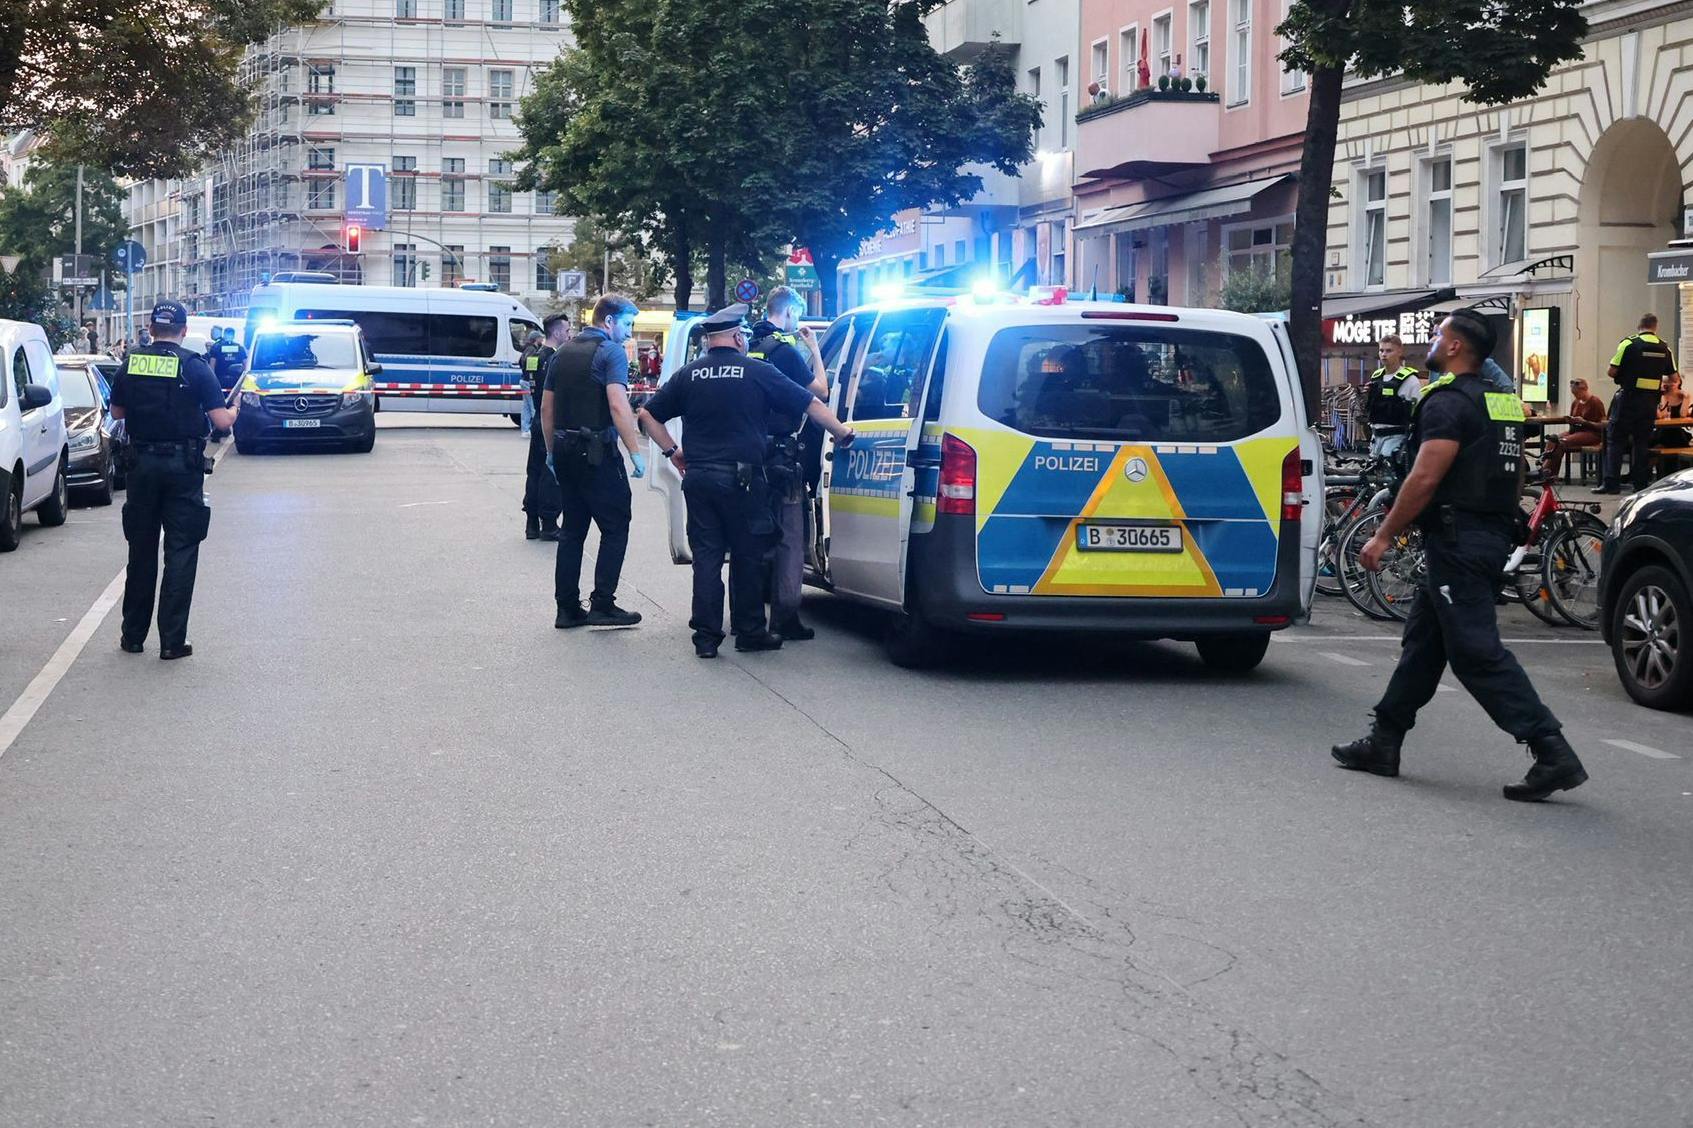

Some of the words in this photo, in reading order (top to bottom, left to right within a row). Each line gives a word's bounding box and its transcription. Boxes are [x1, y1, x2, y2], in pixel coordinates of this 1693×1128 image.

[348, 165, 384, 209] T
[1657, 264, 1689, 278] Krombacher
[156, 304, 178, 313] POLIZEI
[1333, 314, 1372, 344] MÖGE
[1372, 319, 1397, 343] TEE
[129, 355, 179, 376] POLIZEI
[691, 365, 744, 382] POLIZEI
[450, 374, 484, 383] POLIZEI
[846, 449, 896, 481] POLIZEI
[1035, 456, 1099, 472] POLIZEI
[1090, 528, 1101, 545] B
[1117, 529, 1170, 546] 30665
